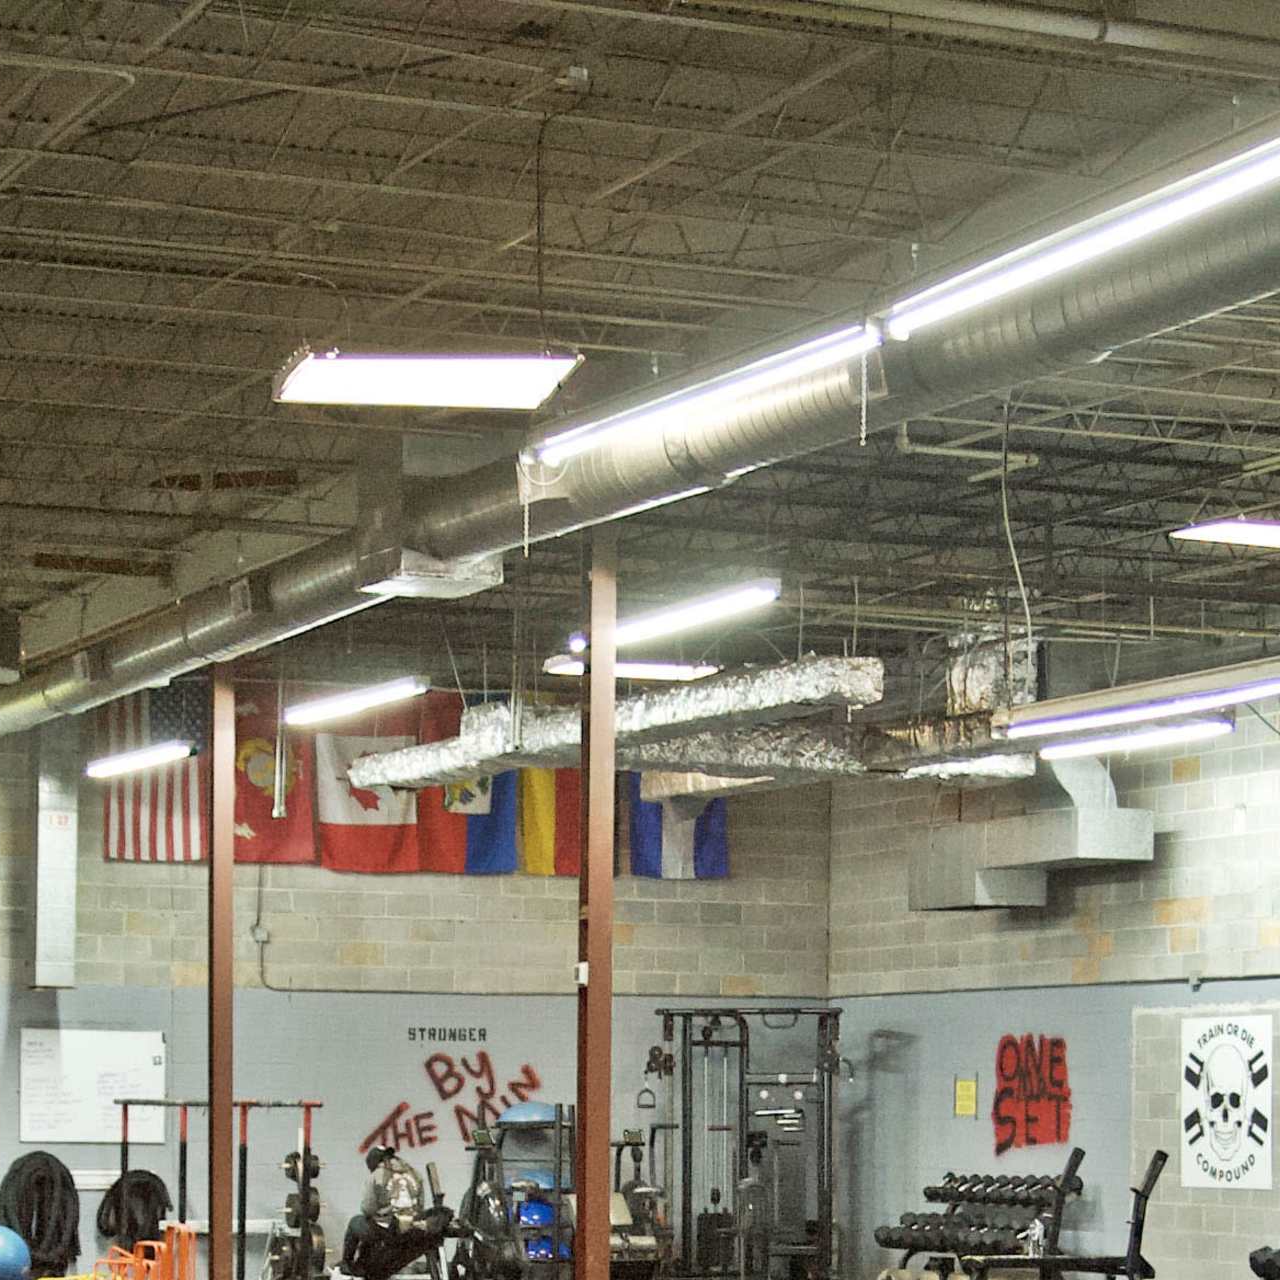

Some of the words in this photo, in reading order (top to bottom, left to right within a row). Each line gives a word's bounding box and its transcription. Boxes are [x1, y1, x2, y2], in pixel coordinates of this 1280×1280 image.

[1197, 1024, 1224, 1048] TRAIN
[1226, 1023, 1239, 1036] OR
[1241, 1029, 1256, 1049] DIE
[997, 1033, 1067, 1096] ONE
[357, 1101, 438, 1153] THE
[993, 1086, 1069, 1156] SET
[1196, 1153, 1256, 1183] COMPOUND
